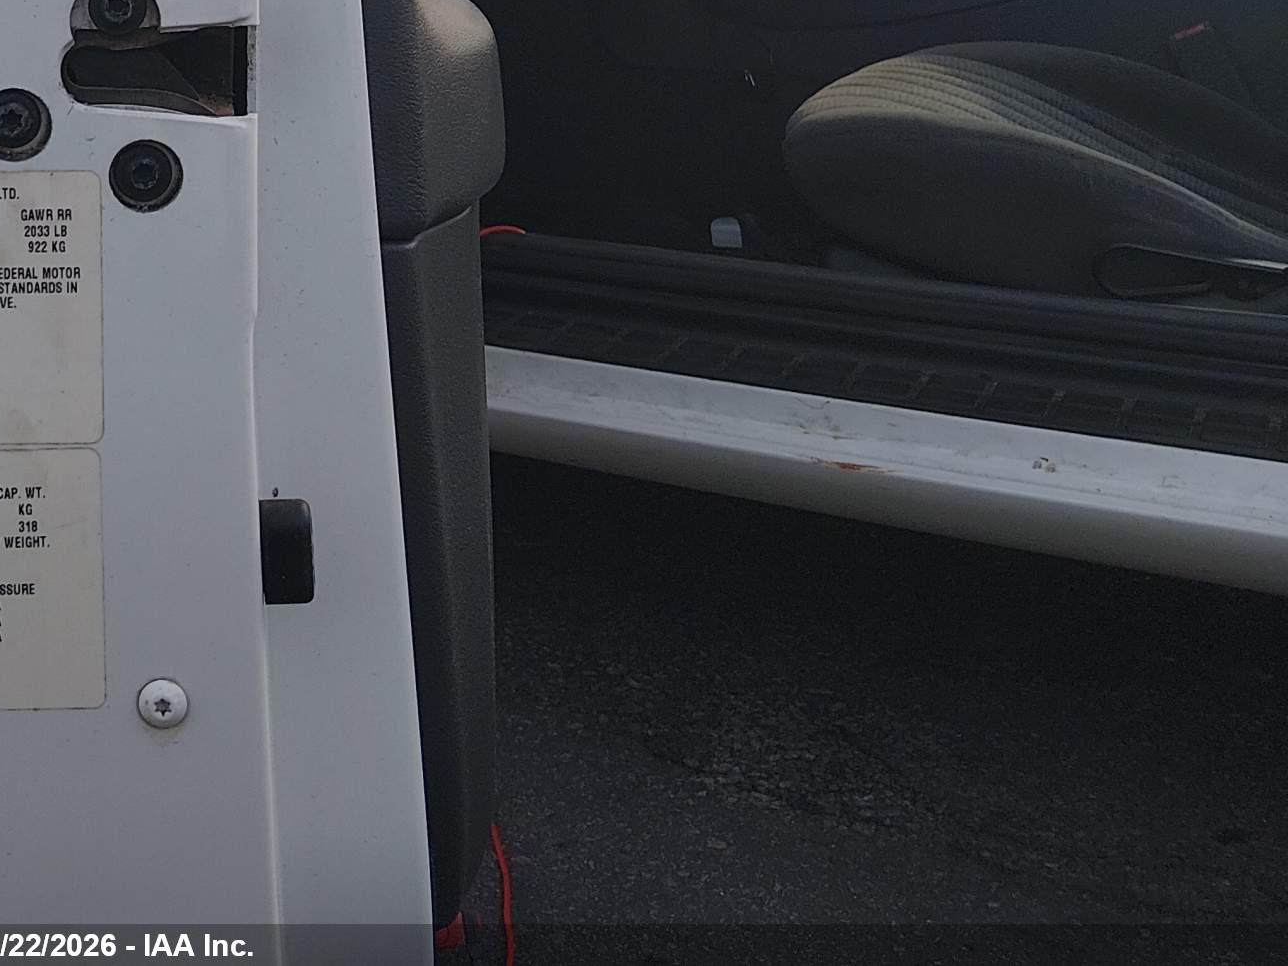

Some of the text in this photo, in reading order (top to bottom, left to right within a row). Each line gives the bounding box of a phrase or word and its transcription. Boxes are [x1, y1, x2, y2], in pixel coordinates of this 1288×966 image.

[21, 209, 53, 221] GAWR
[57, 209, 72, 221] RR
[24, 225, 50, 237] 2033
[54, 225, 67, 237] LB
[42, 267, 81, 279] MOTOR
[67, 282, 77, 293] IN
[25, 487, 45, 499] WT.
[18, 503, 32, 516] KG
[4, 536, 50, 548] WEIGHT.
